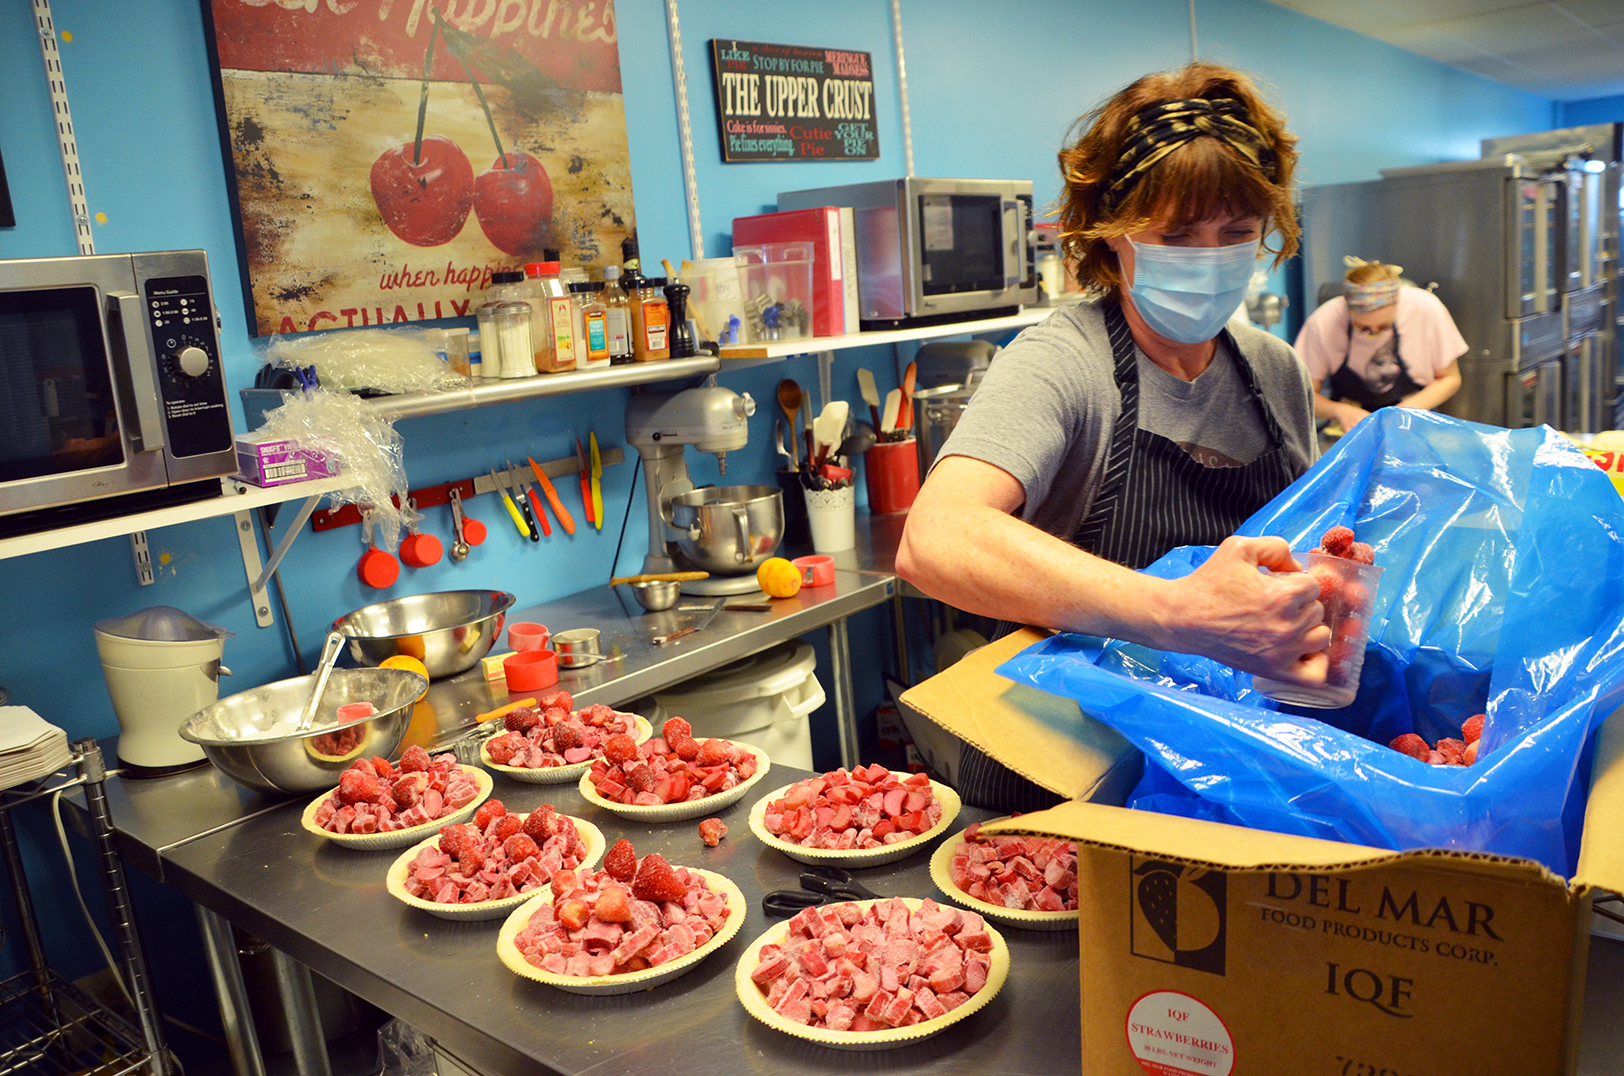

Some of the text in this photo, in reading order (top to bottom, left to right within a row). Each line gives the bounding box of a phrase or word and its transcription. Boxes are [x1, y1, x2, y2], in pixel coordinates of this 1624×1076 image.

[721, 49, 750, 61] LIKE
[779, 57, 790, 71] BY
[791, 58, 810, 73] FOR
[810, 60, 824, 75] PIE
[722, 72, 872, 120] THE UPPER CRUST
[727, 119, 746, 133] Cake
[746, 121, 753, 133] is
[753, 120, 764, 133] for
[790, 125, 833, 140] Cutie
[838, 122, 869, 132] GET
[729, 134, 741, 152] Pie
[834, 130, 874, 140] YOUR
[844, 138, 867, 147] PIE
[801, 142, 825, 156] Pie
[845, 145, 867, 156] ON
[380, 263, 440, 290] when
[1264, 872, 1505, 942] DEL MAR
[1261, 907, 1499, 966] FOOD PRODUCTS CORP.
[1325, 961, 1413, 1018] IQF
[1167, 1008, 1191, 1022] IQF
[1131, 1022, 1229, 1054] STRAWBERRIES
[1152, 1046, 1168, 1056] LBS.
[1169, 1050, 1185, 1060] NET
[1185, 1054, 1217, 1068] WEIGHT
